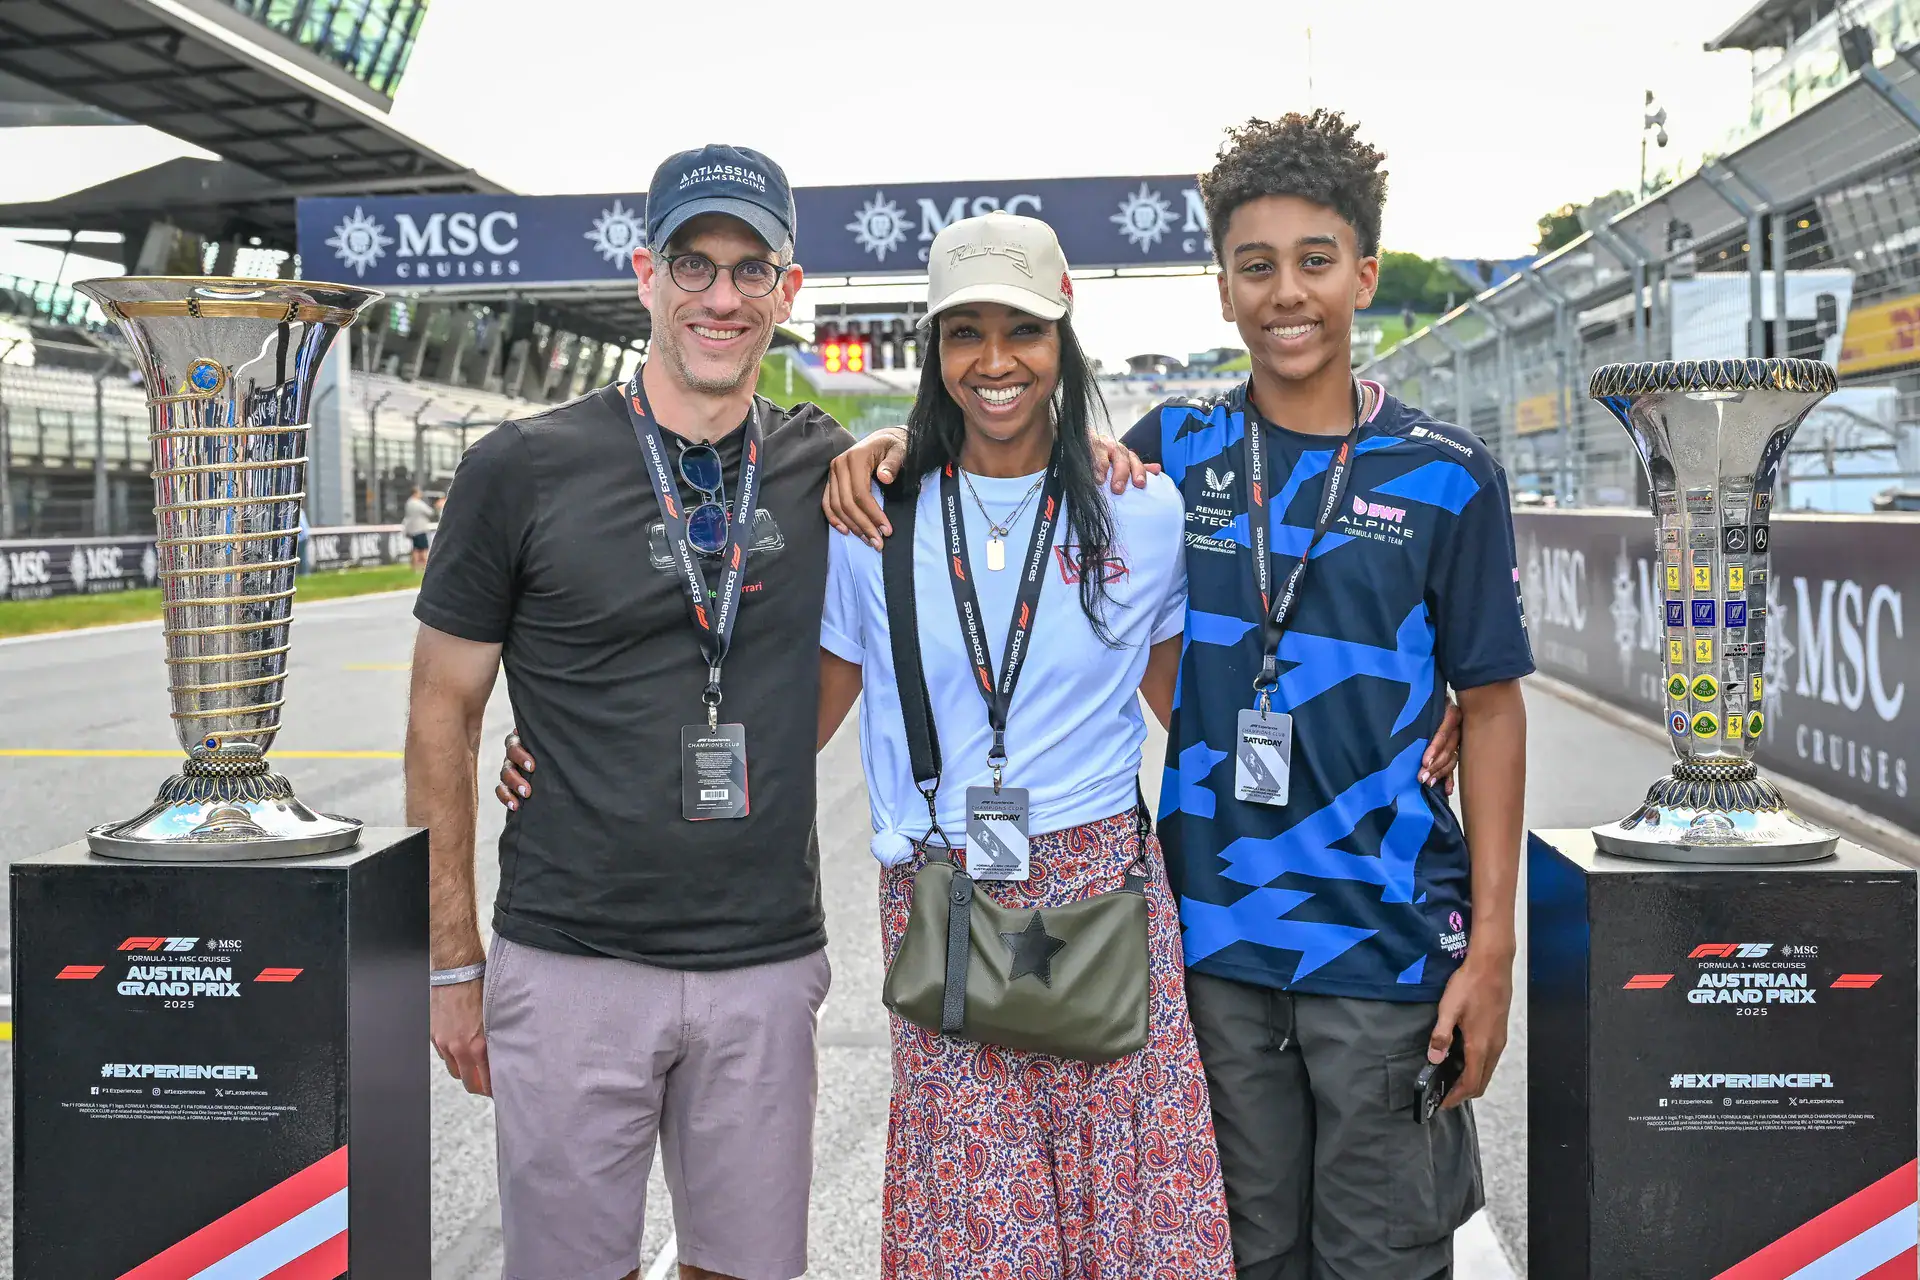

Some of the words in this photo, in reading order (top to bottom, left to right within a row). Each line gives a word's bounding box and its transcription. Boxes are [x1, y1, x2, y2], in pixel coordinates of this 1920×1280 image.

[690, 165, 765, 186] ATLASSIAN
[395, 211, 519, 257] MSC
[396, 260, 520, 278] CRUISES
[1251, 422, 1261, 480] Experiences
[1428, 430, 1473, 458] Microsoft
[646, 434, 670, 492] Experiences
[739, 464, 755, 524] Experiences
[1321, 465, 1344, 524] Experiences
[1186, 512, 1237, 528] E-TECH
[1196, 505, 1232, 516] RENAULT
[1367, 503, 1406, 523] BWT
[948, 496, 960, 554] Experiences
[1337, 515, 1414, 538] ALPINE
[1345, 528, 1372, 539] FORMULA
[1388, 536, 1403, 545] TEAM
[1029, 521, 1050, 582] Experiences
[1193, 544, 1236, 554] moser-watches.com
[1257, 526, 1267, 590] Experiences
[10, 550, 50, 585] MSC
[86, 547, 123, 579] MSC
[678, 540, 702, 603] Experiences
[742, 582, 762, 593] rrari
[1542, 546, 1586, 632] MSC
[717, 571, 737, 634] Experiences
[964, 601, 984, 665] Experiences
[1793, 576, 1904, 722] MSC
[1003, 630, 1024, 693] Experiences
[1243, 736, 1282, 746] SATURDAY
[1797, 724, 1907, 798] CRUISES
[219, 940, 242, 948] MSC
[1440, 932, 1465, 945] CHANGE
[1448, 940, 1467, 951] WORLD
[1794, 946, 1818, 954] MSC
[126, 966, 232, 981] AUSTRIAN
[1697, 974, 1807, 988] AUSTRIAN
[117, 981, 189, 996] GRAND
[192, 982, 241, 997] PRIX
[1687, 989, 1763, 1004] GRAND
[1766, 989, 1816, 1004] PRIX
[164, 1001, 195, 1009] 2025
[1736, 1008, 1767, 1016] 2025
[101, 1064, 258, 1079] #EXPERIENCEF1
[1670, 1074, 1833, 1088] #EXPERIENCEF1
